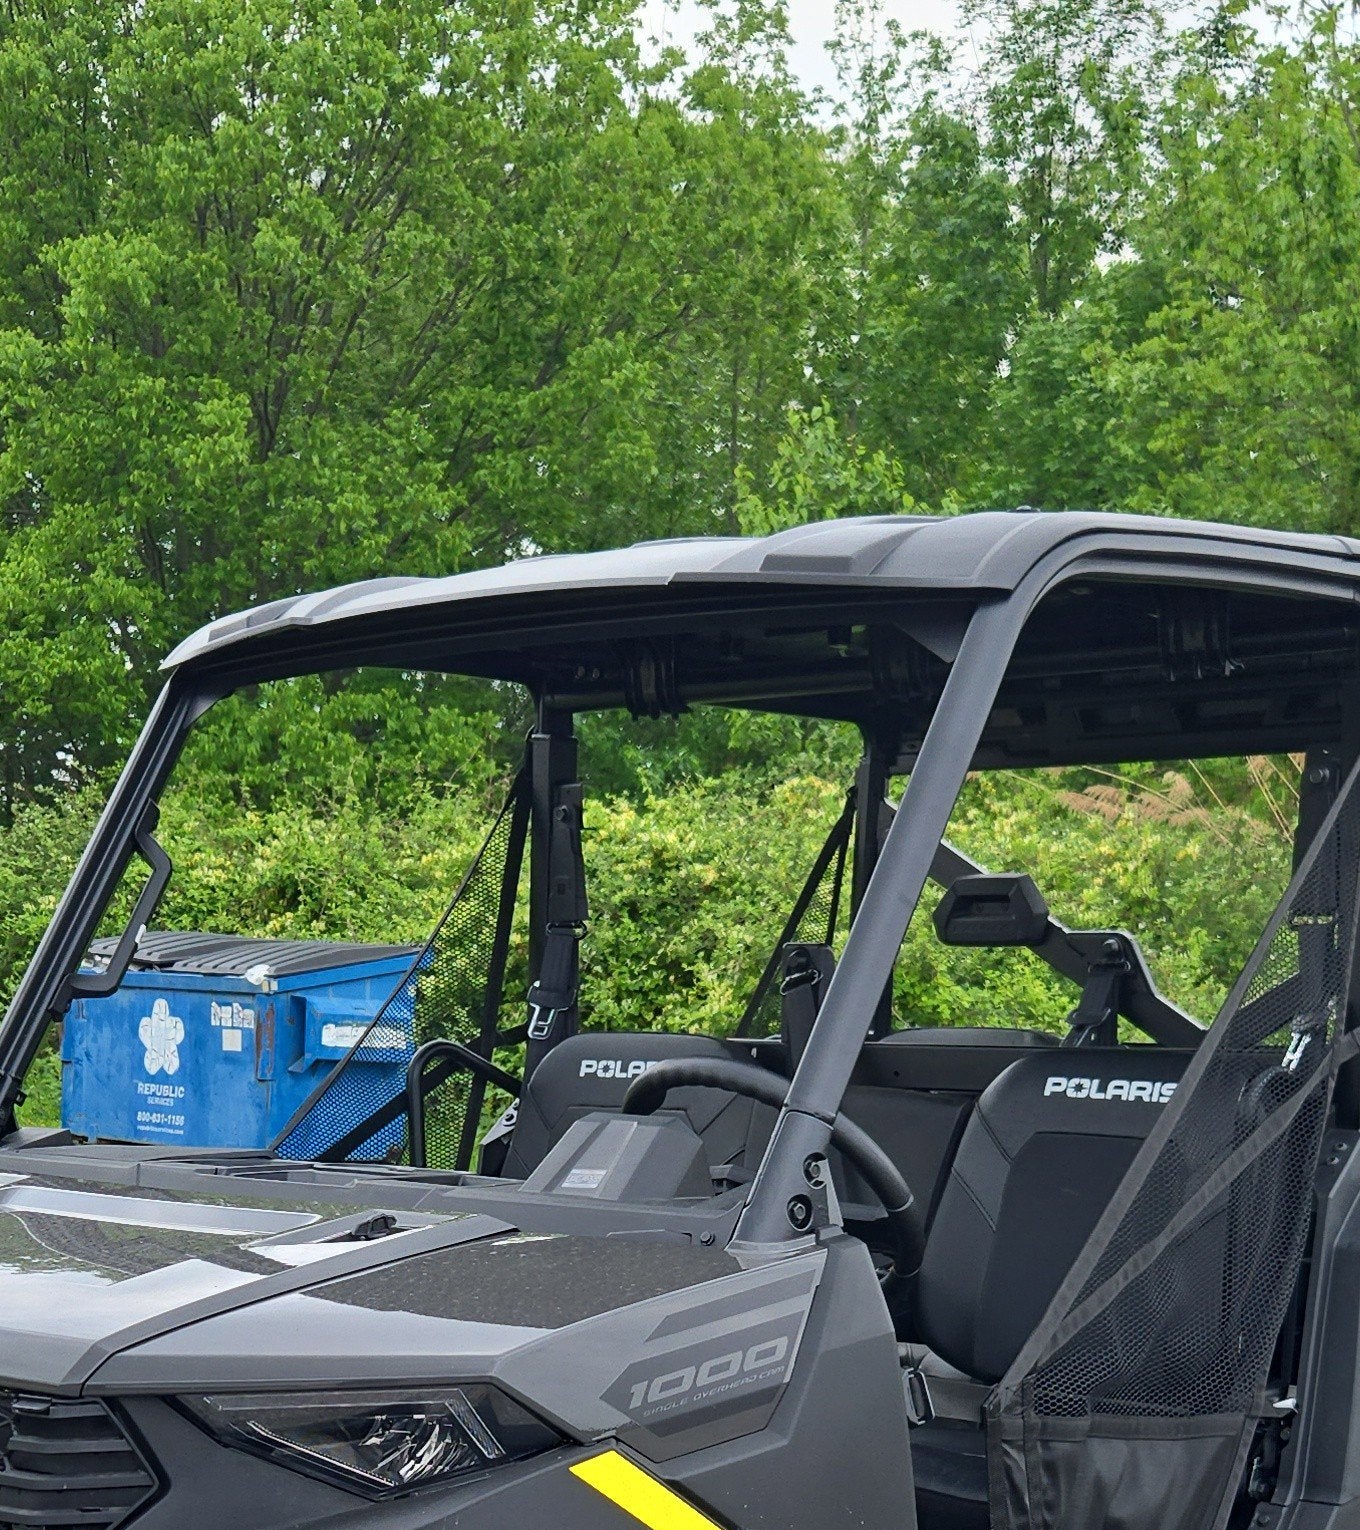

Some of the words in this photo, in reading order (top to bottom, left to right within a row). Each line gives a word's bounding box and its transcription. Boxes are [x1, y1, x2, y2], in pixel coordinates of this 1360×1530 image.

[580, 1059, 658, 1078] POLA
[137, 1082, 185, 1099] REPUBLIC
[1043, 1076, 1178, 1104] POLARIS
[629, 1335, 788, 1410] 1000
[643, 1397, 689, 1418] SINGLE
[693, 1374, 757, 1401] OVERHEAD
[758, 1366, 785, 1380] CAM
